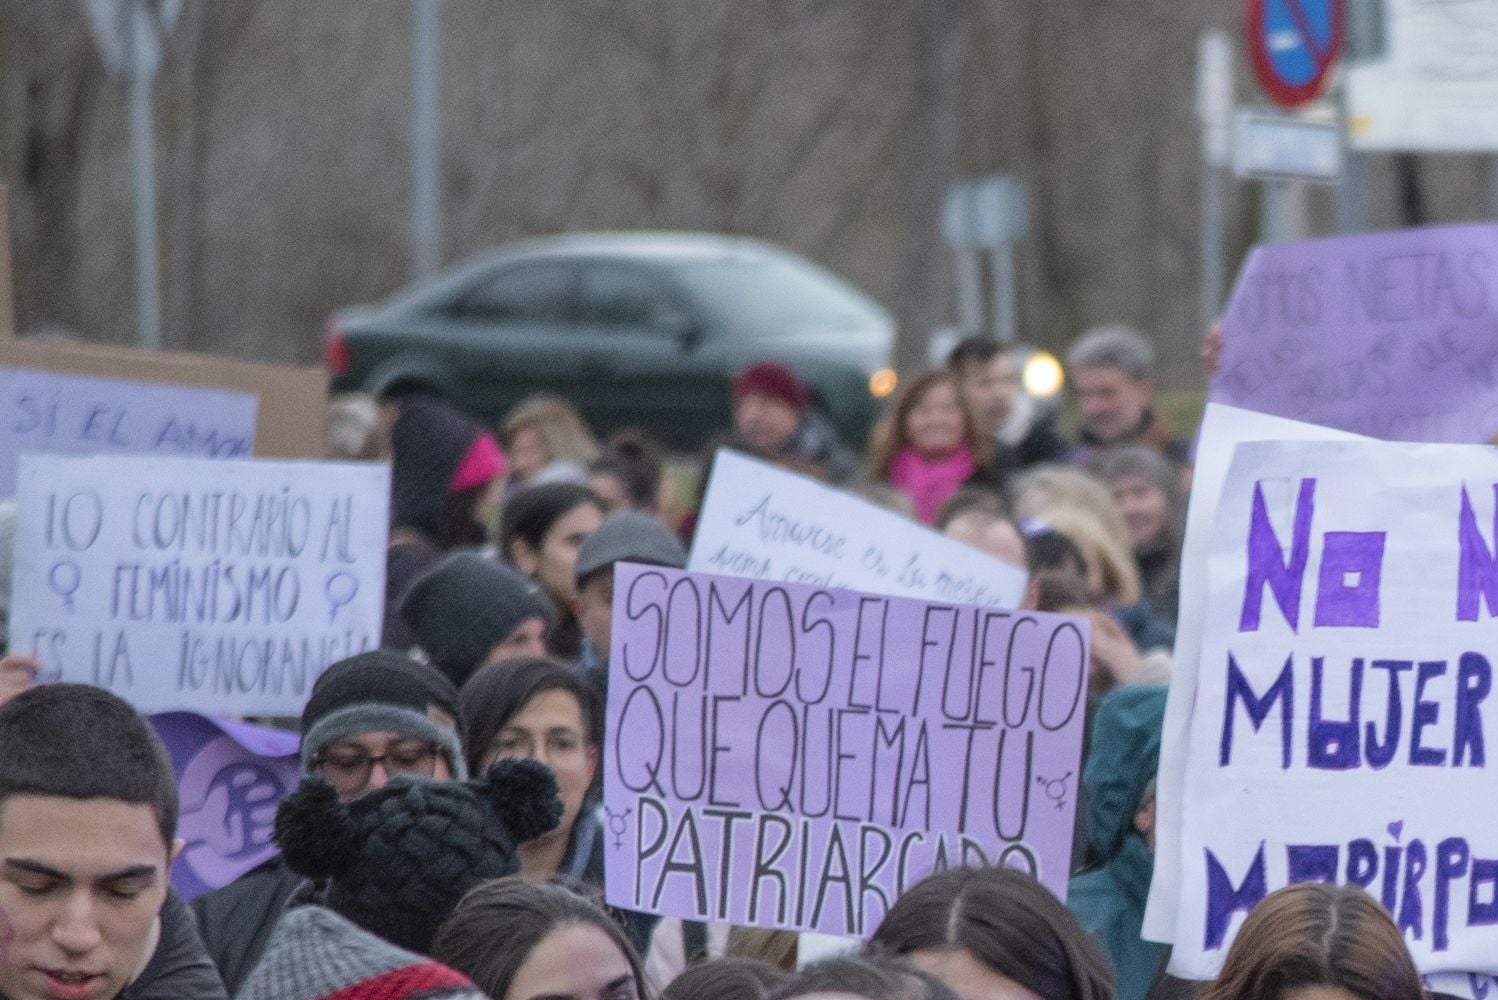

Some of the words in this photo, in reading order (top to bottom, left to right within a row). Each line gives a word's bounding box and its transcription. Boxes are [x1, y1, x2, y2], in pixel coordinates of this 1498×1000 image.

[82, 406, 129, 447] EL
[132, 484, 312, 560] CONTRARIO
[319, 494, 357, 565] AL
[1237, 476, 1388, 636] NO
[111, 558, 301, 625] FEMINISMO
[622, 570, 836, 706] SOMOS
[846, 597, 901, 716] EL
[911, 606, 1086, 733] FUEGO
[615, 684, 741, 809] QUE
[754, 699, 931, 834] QUEMA
[941, 722, 1036, 843] TU
[1218, 649, 1493, 771] MUJER
[633, 797, 1041, 938] PATRIAR
